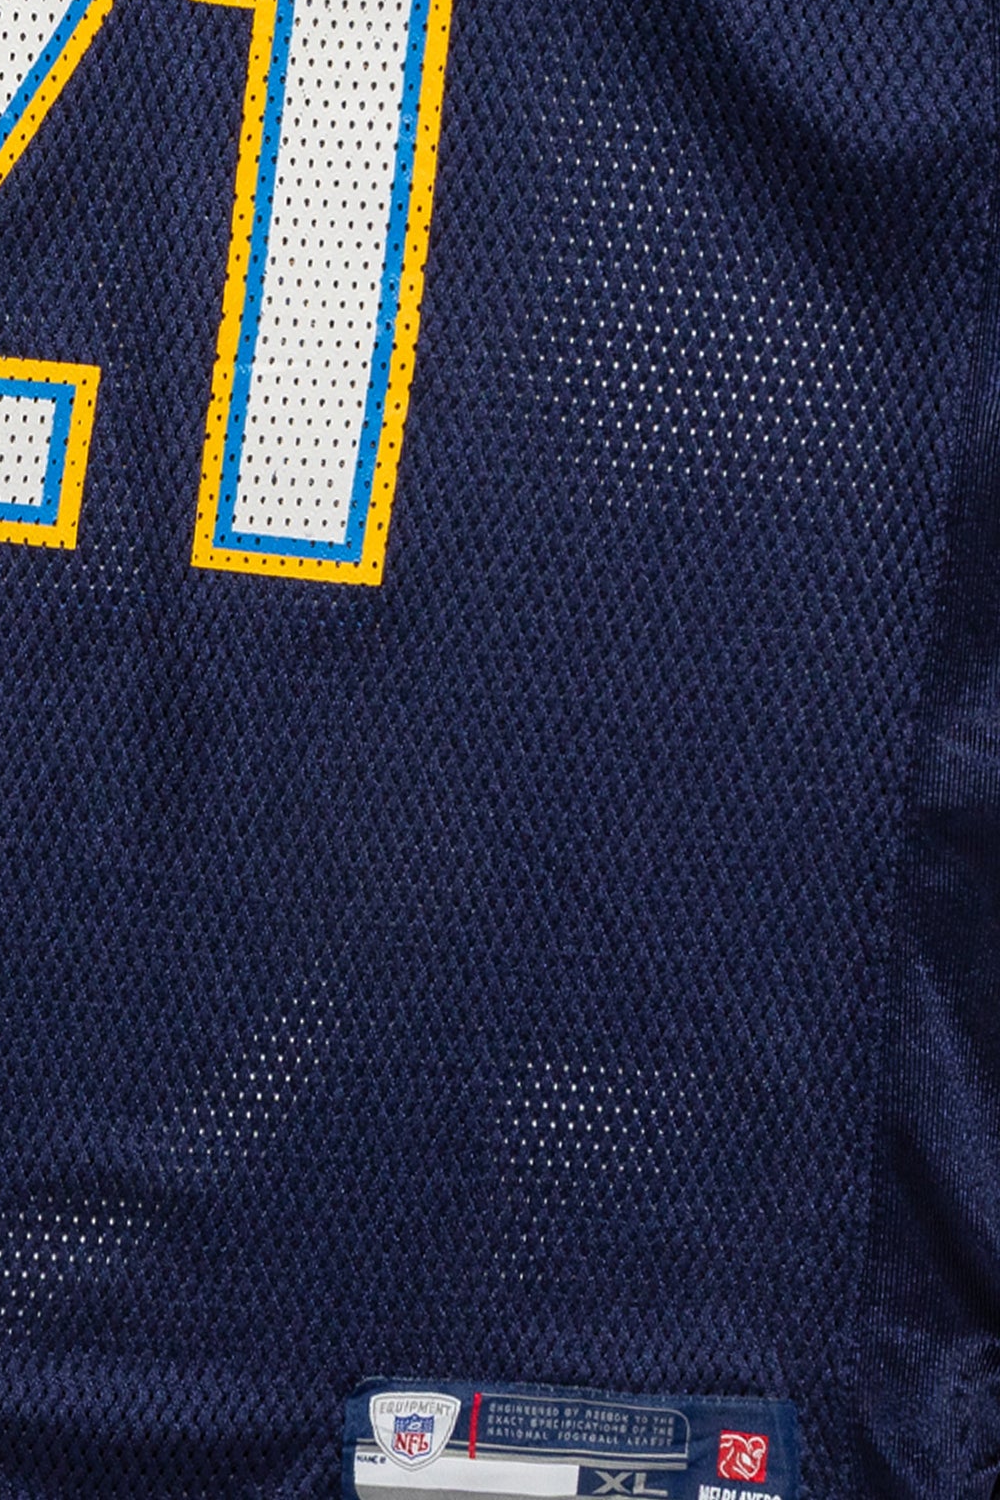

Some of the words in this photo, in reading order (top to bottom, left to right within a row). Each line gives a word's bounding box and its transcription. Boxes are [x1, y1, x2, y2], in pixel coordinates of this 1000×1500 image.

[379, 1400, 453, 1416] EQUIPMENT
[487, 1414, 524, 1426] EXACT
[634, 1415, 648, 1424] TO
[487, 1427, 548, 1440] NATIONAL
[394, 1433, 430, 1455] NFL
[592, 1470, 668, 1497] XL
